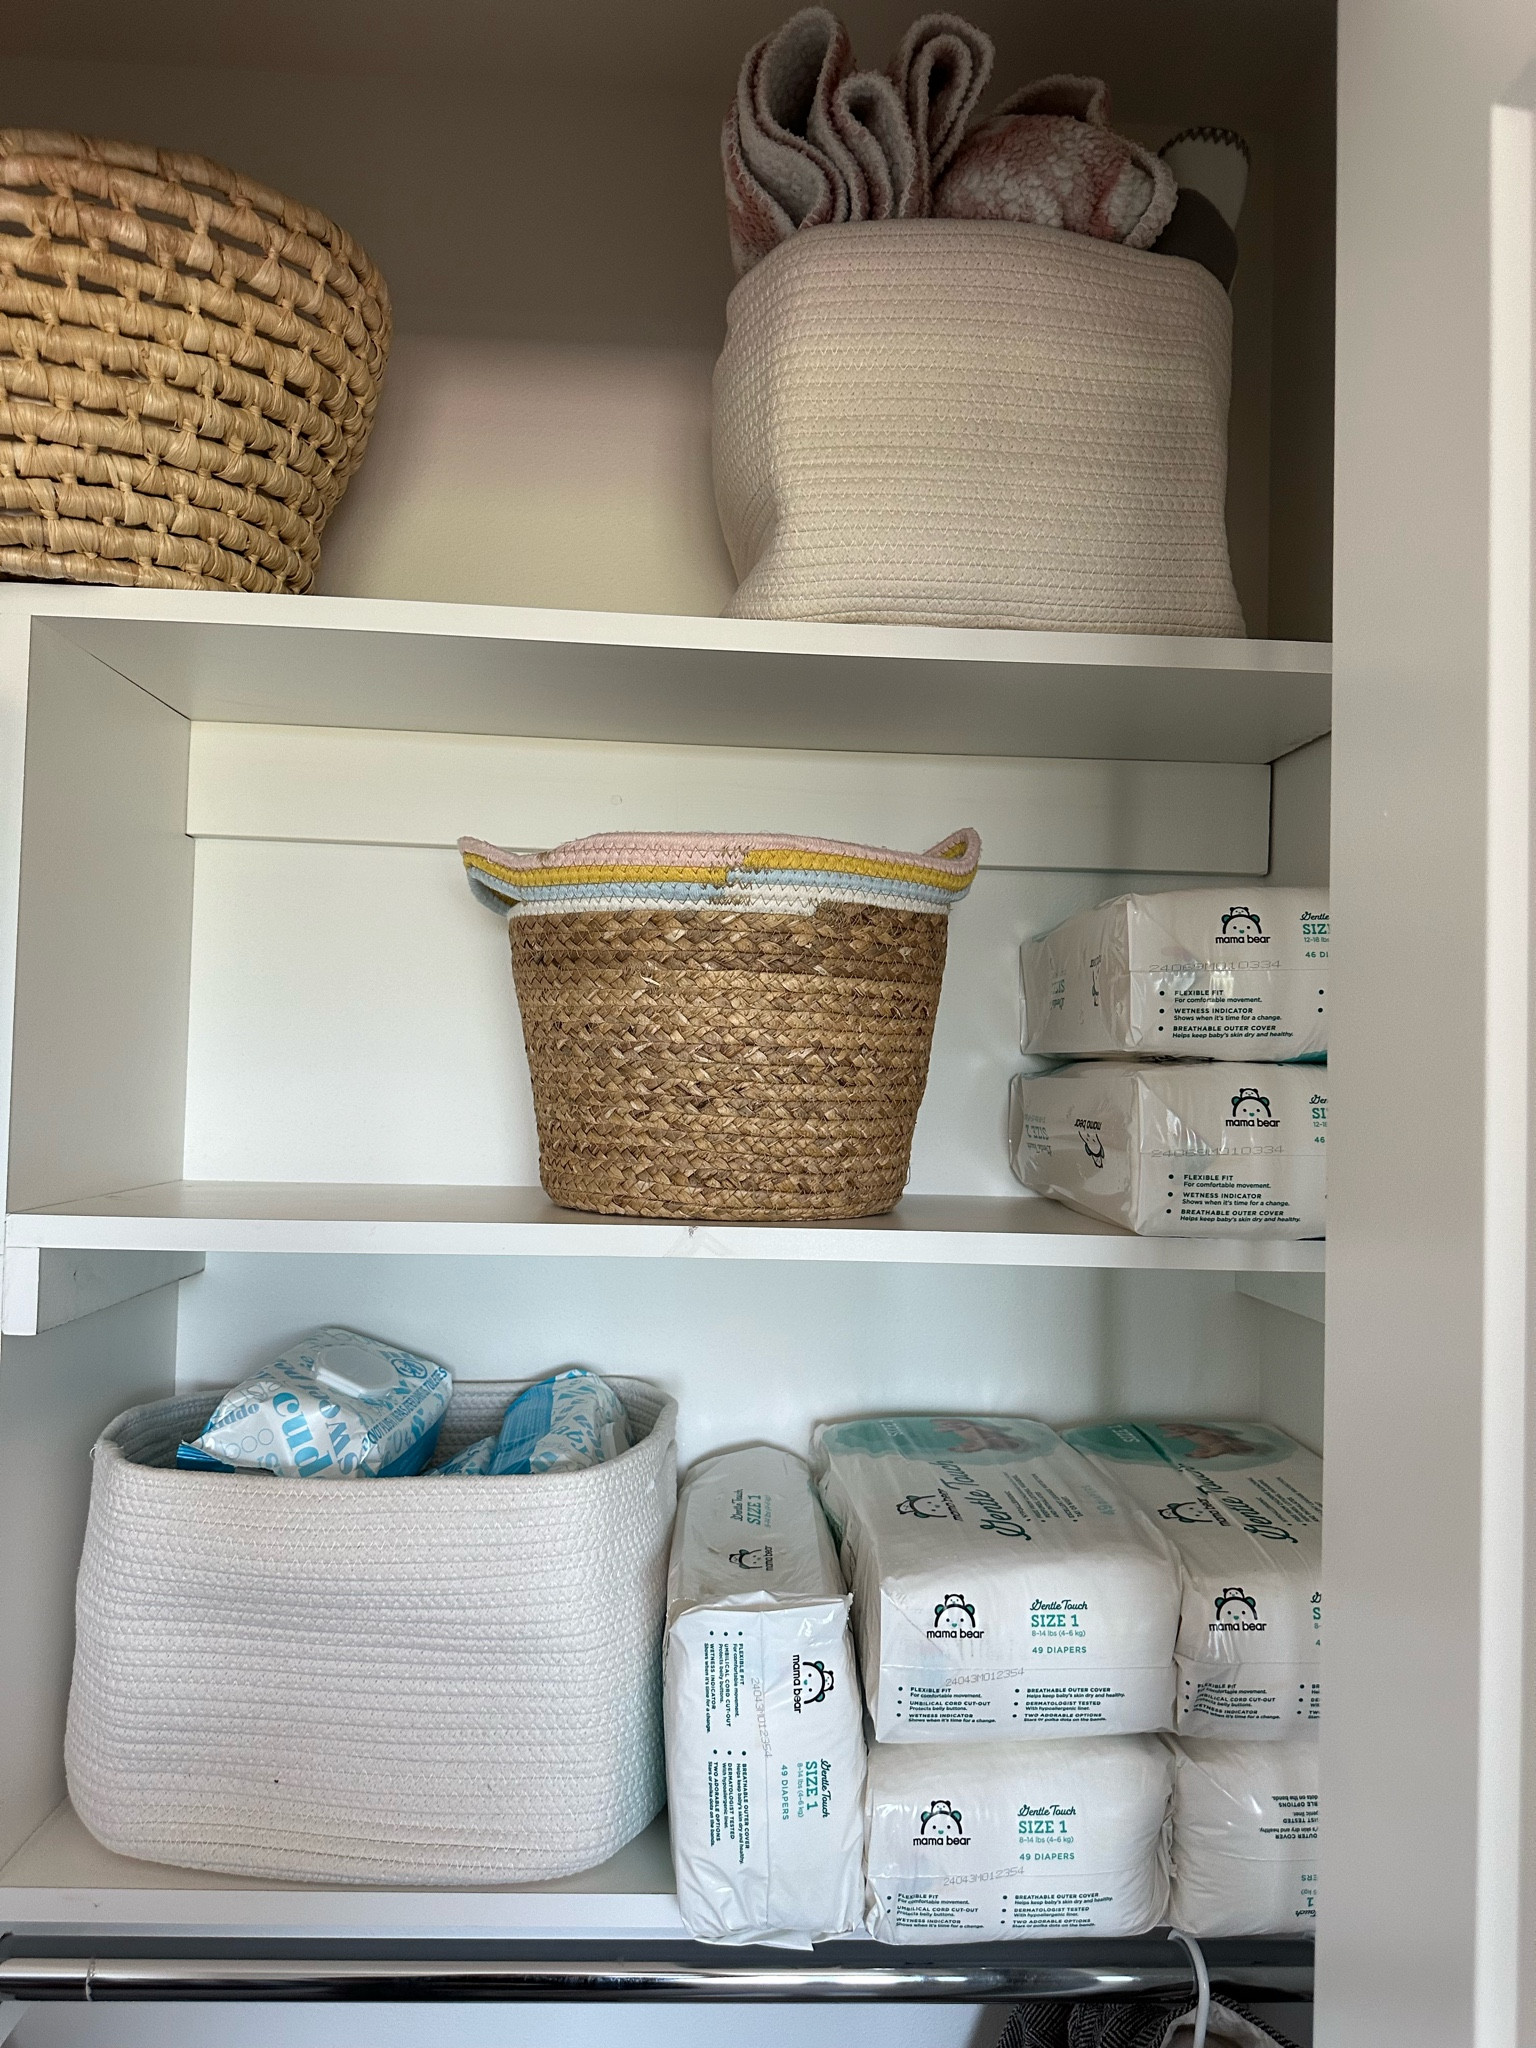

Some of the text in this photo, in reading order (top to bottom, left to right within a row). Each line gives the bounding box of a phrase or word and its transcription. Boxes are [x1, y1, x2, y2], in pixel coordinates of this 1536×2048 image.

[1303, 923, 1328, 935] SIZ
[1215, 935, 1271, 944] mama bear
[1256, 1118, 1280, 1127] bear
[1183, 1192, 1219, 1200] WETNESS
[273, 1392, 332, 1477] cud
[747, 1502, 761, 1525] SIZE
[765, 1545, 773, 1571] mama bear
[1030, 1599, 1088, 1611] Gentle Touch
[1031, 1614, 1079, 1627] SIZE 1
[1209, 1622, 1267, 1632] mama bear
[926, 1629, 984, 1638] mama bear
[1032, 1646, 1086, 1654] 49 DIAPERS
[945, 1667, 1025, 1687] 24043M012354
[793, 1654, 802, 1713] mama bear
[806, 1761, 818, 1810] SIZE 1
[821, 1759, 831, 1818] Gentle Touch
[781, 1764, 789, 1820] 49 DIAPERS
[1018, 1804, 1076, 1816] Gentle Touch
[1019, 1820, 1067, 1834] SIZE 1
[913, 1836, 971, 1846] mama bear
[1019, 1836, 1074, 1844] 8-14 lbs (4-6 kg)
[1019, 1852, 1075, 1861] 49 DIAPERS
[943, 1866, 1024, 1886] 24043M012354
